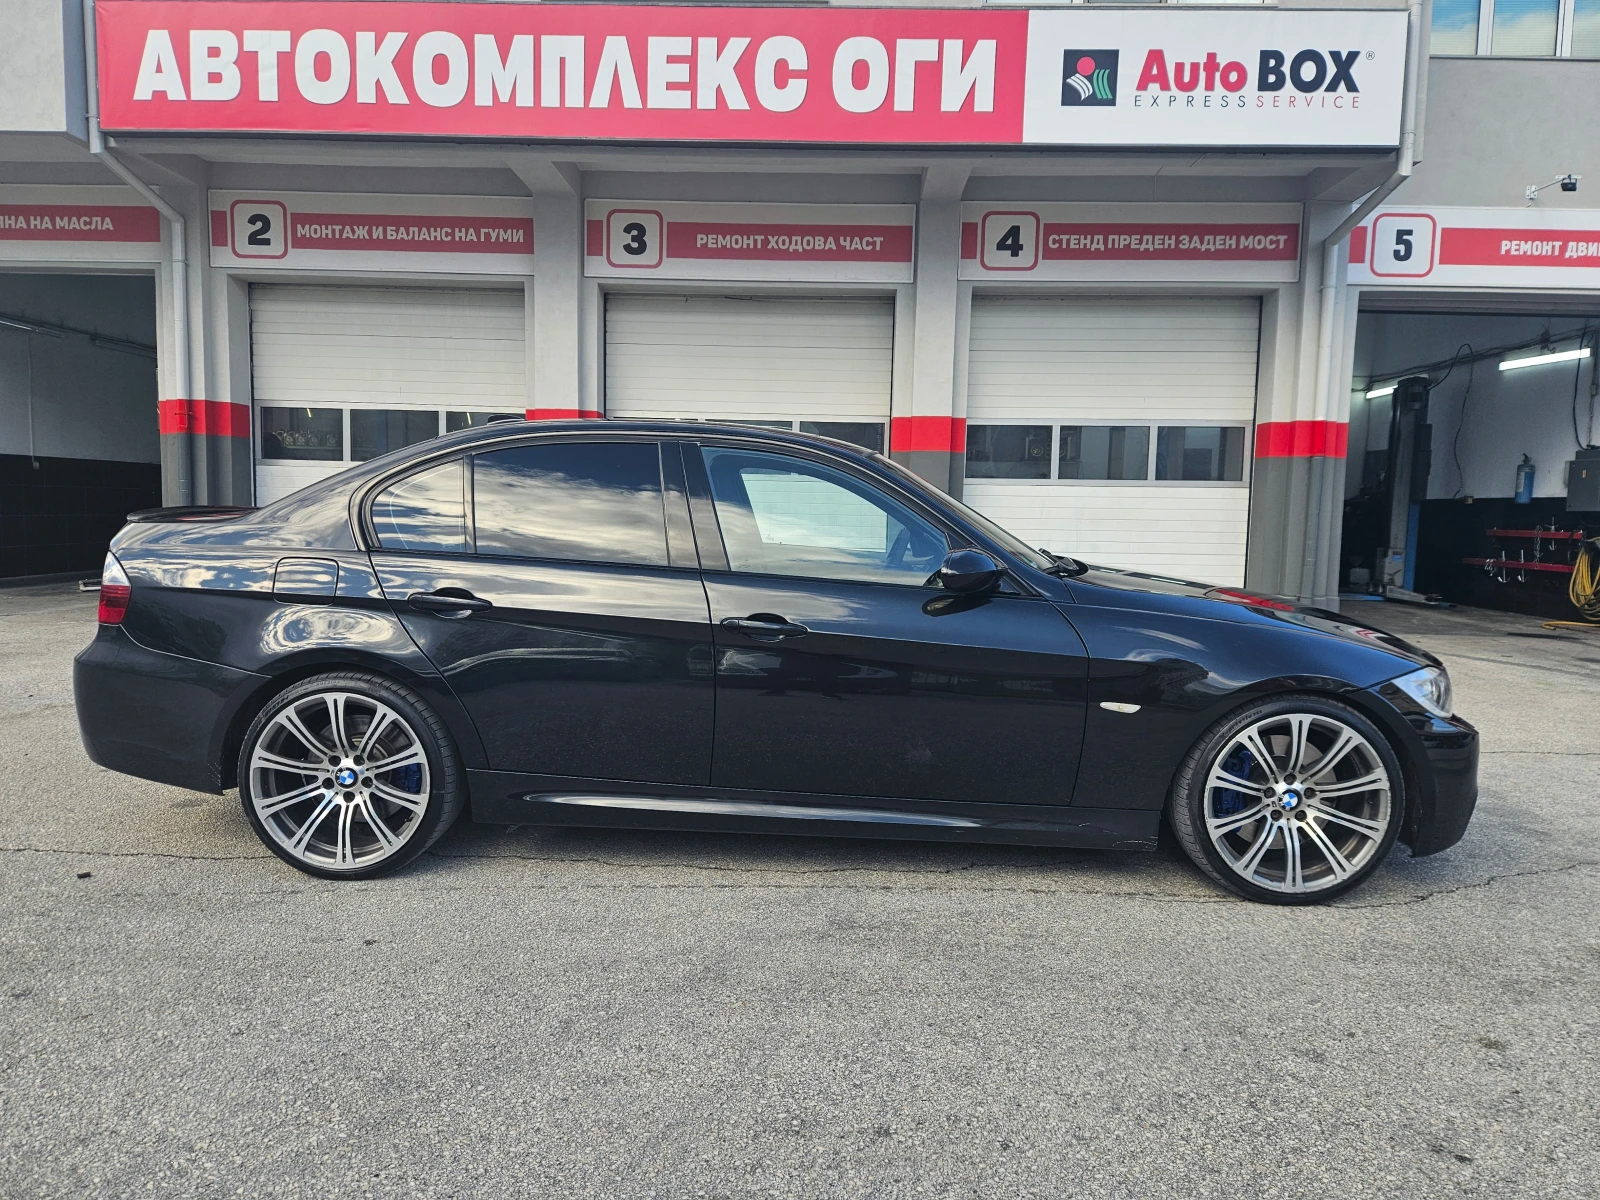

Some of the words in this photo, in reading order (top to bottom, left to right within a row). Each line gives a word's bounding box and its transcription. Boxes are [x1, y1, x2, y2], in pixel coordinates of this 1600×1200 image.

[133, 28, 808, 112] АВТОКОМПЛЕКС
[832, 36, 997, 112] ОГИ
[1136, 49, 1248, 92] Auto
[1257, 49, 1361, 93] BOX
[1134, 95, 1246, 108] EXPRESS
[1256, 95, 1360, 109] SERVICE
[30, 215, 53, 230] НА
[56, 216, 114, 231] МАСЛА
[247, 213, 272, 246] 2
[297, 223, 370, 240] МОНТАЖ
[372, 225, 384, 240] И
[386, 226, 452, 242] БАЛАНС
[454, 227, 478, 242] НА
[480, 228, 524, 243] ГУМИ
[623, 222, 648, 256] 3
[696, 233, 765, 249] РЕМОНТ
[767, 235, 837, 252] ХОДОВА
[839, 236, 884, 251] ЧАСТ
[995, 224, 1024, 258] 4
[1048, 234, 1105, 251] СТЕНД
[1107, 234, 1176, 251] ПРЕДЕН
[1178, 234, 1237, 251] ЗАДЕН
[1239, 235, 1288, 250] МОСТ
[1393, 229, 1414, 262] 5
[1500, 240, 1563, 256] РЕМОНТ
